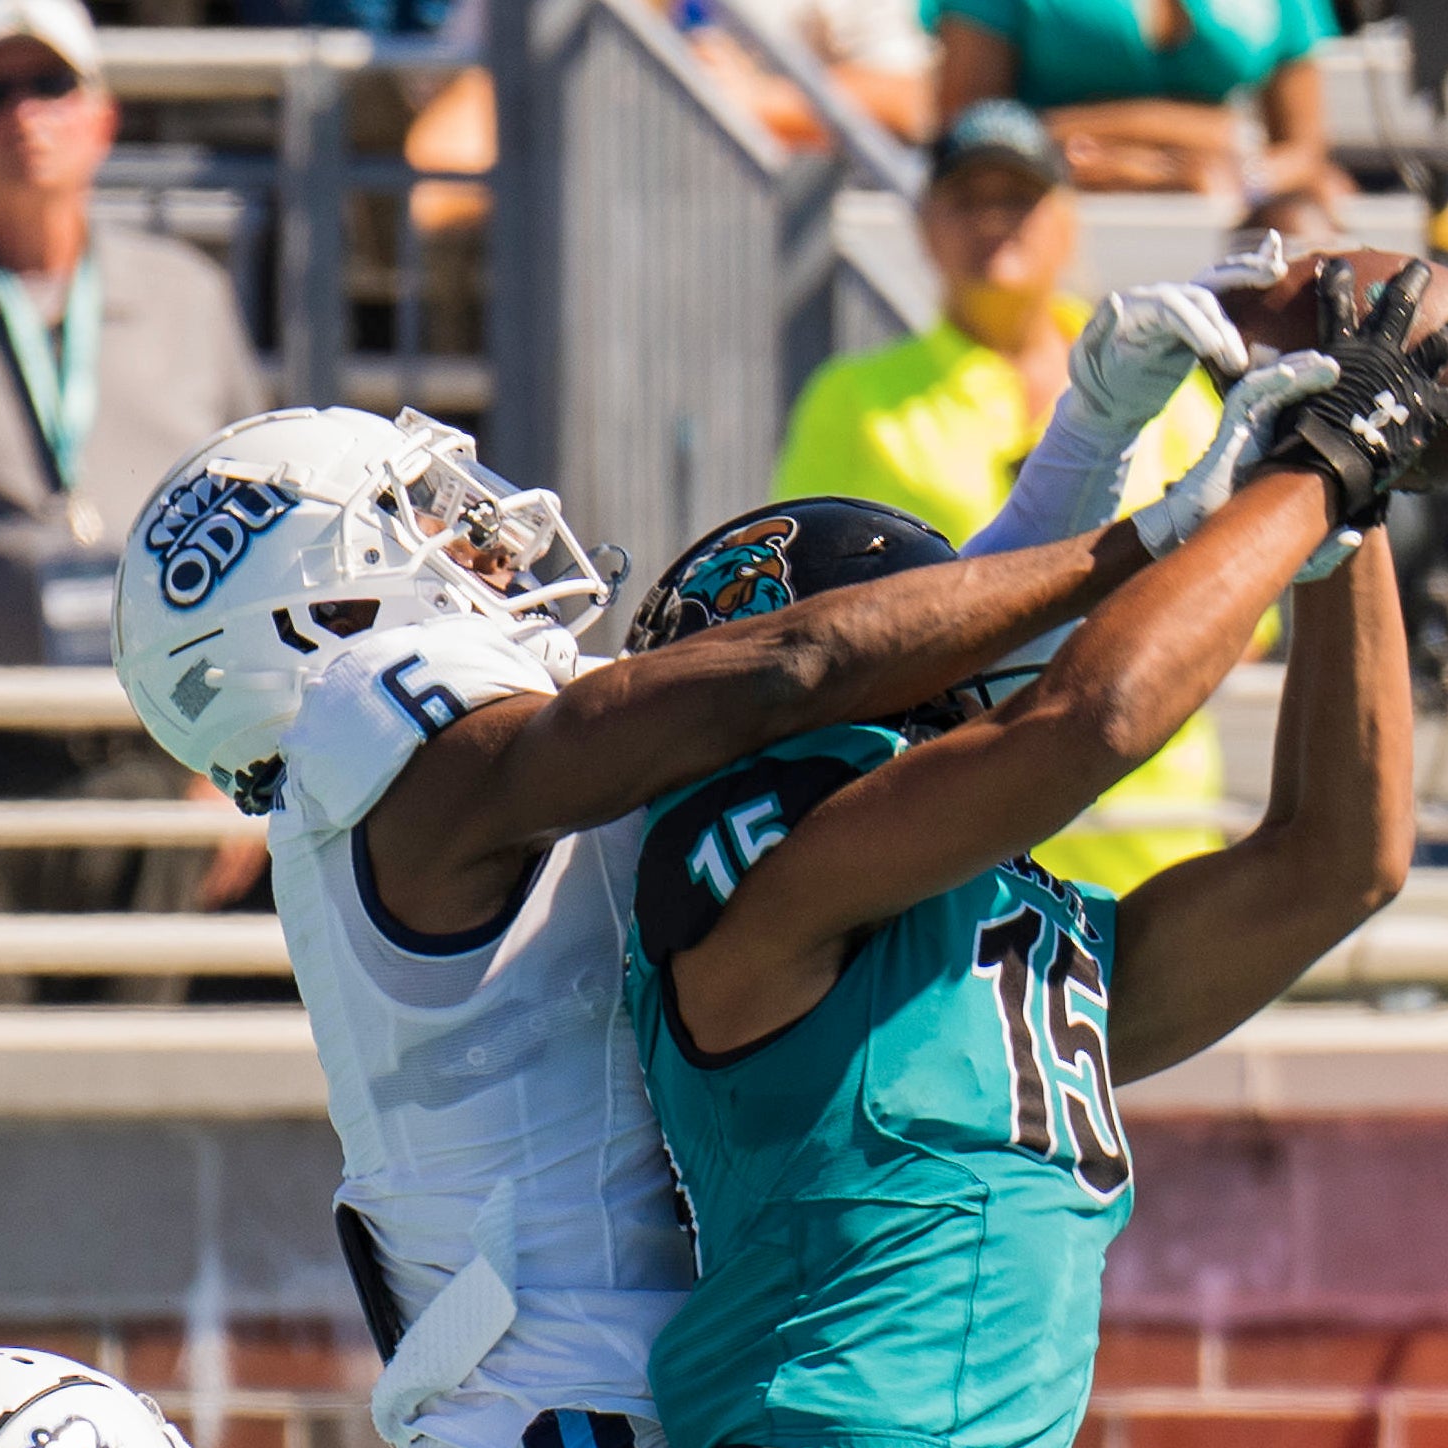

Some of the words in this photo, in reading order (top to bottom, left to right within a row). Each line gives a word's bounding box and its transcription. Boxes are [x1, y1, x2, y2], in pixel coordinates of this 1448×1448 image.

[161, 473, 299, 610] ODU
[374, 651, 471, 742] 6
[971, 900, 1135, 1205] 15
